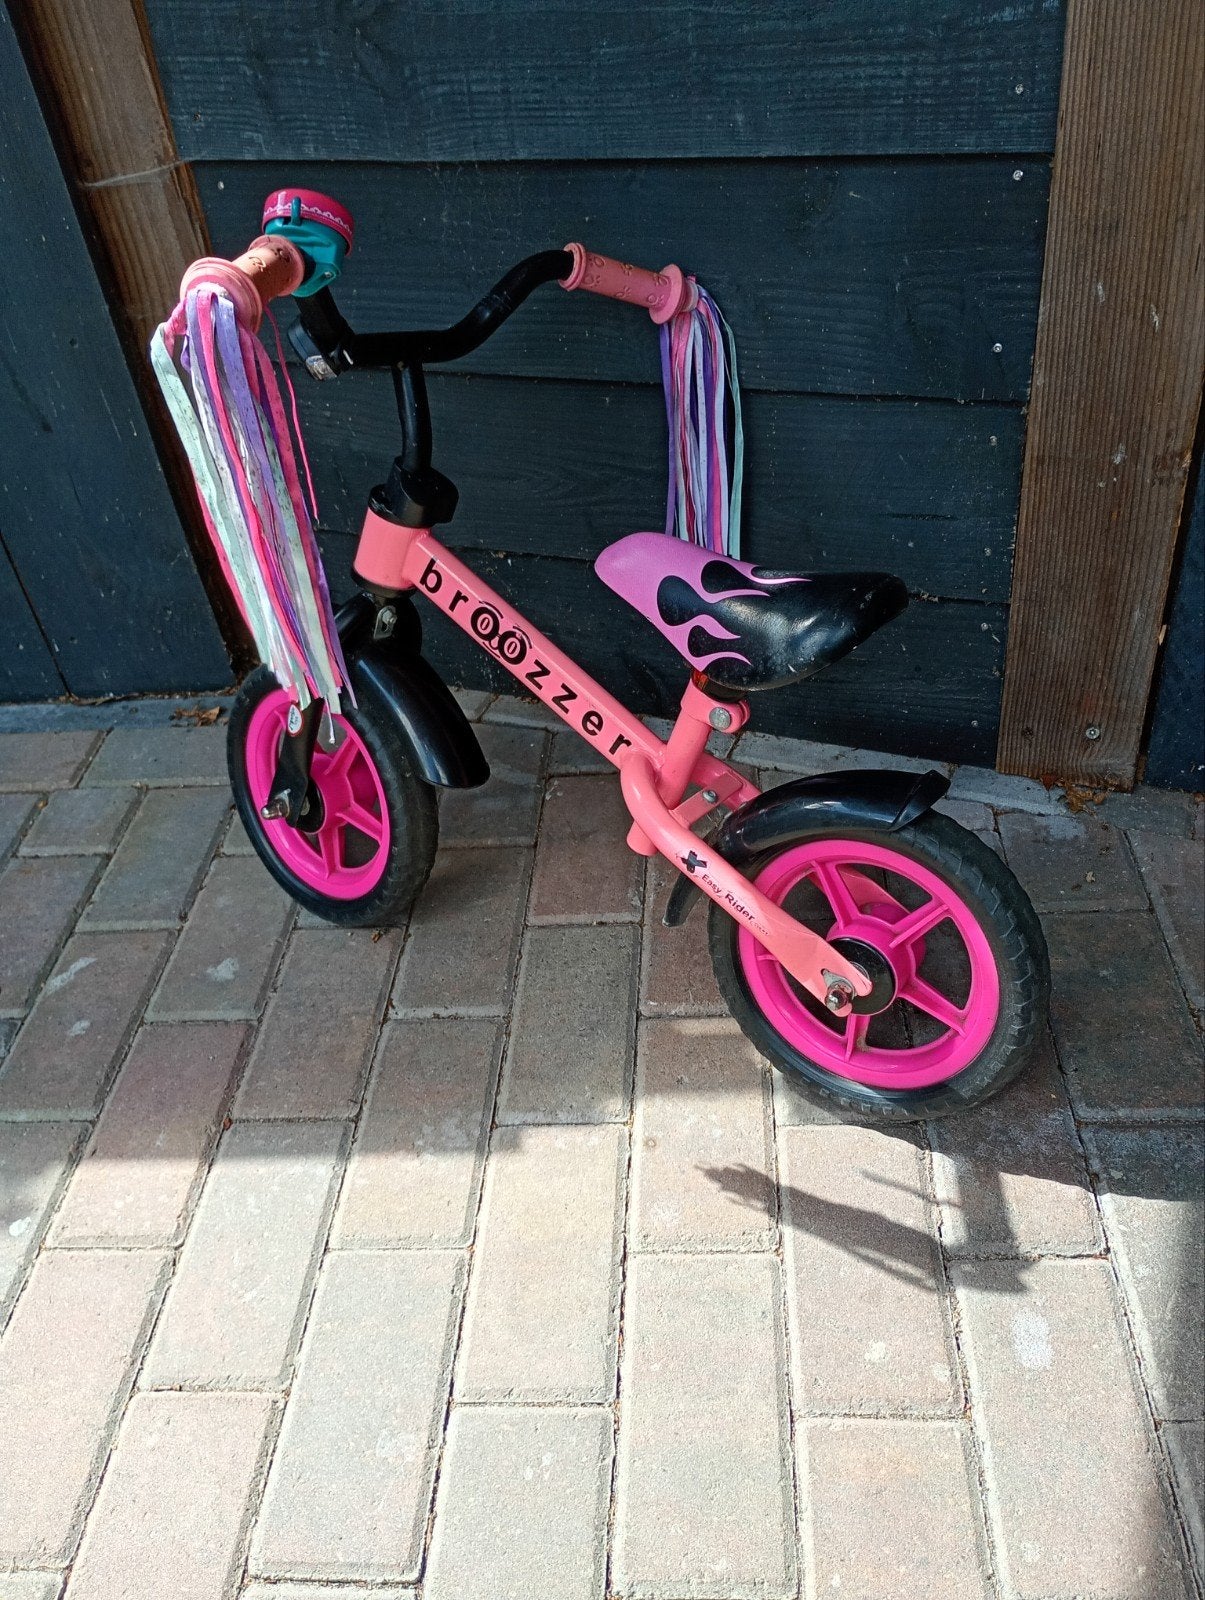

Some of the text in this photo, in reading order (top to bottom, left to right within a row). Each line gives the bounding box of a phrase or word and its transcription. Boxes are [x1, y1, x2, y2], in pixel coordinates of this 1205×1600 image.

[419, 557, 632, 756] broozzer
[701, 873, 755, 921] Easy Rider
